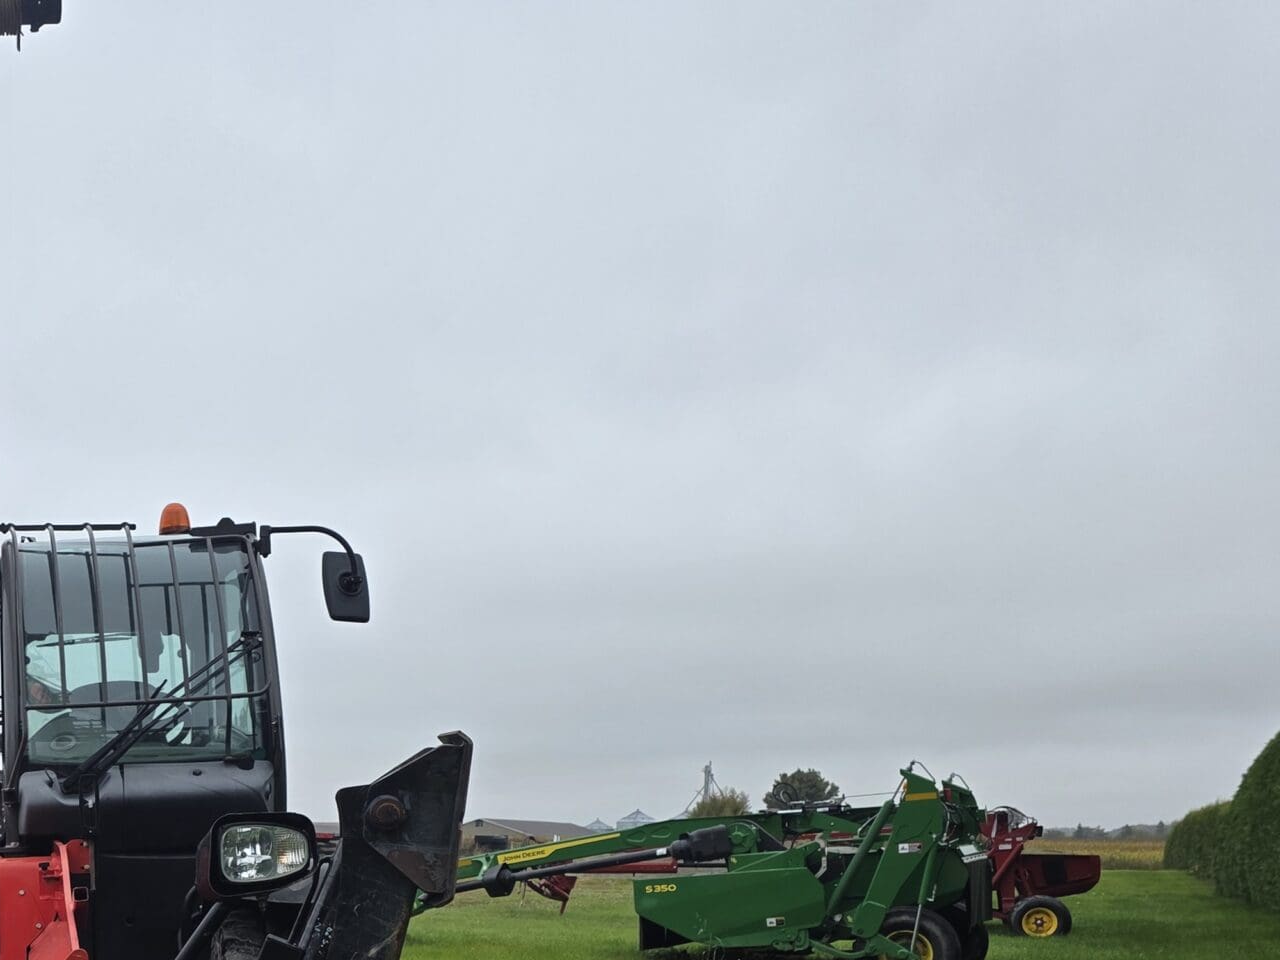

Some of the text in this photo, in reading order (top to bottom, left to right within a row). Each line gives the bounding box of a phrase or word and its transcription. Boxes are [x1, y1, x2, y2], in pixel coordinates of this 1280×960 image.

[504, 850, 546, 862] JOHN DEERE
[645, 884, 677, 893] S350
